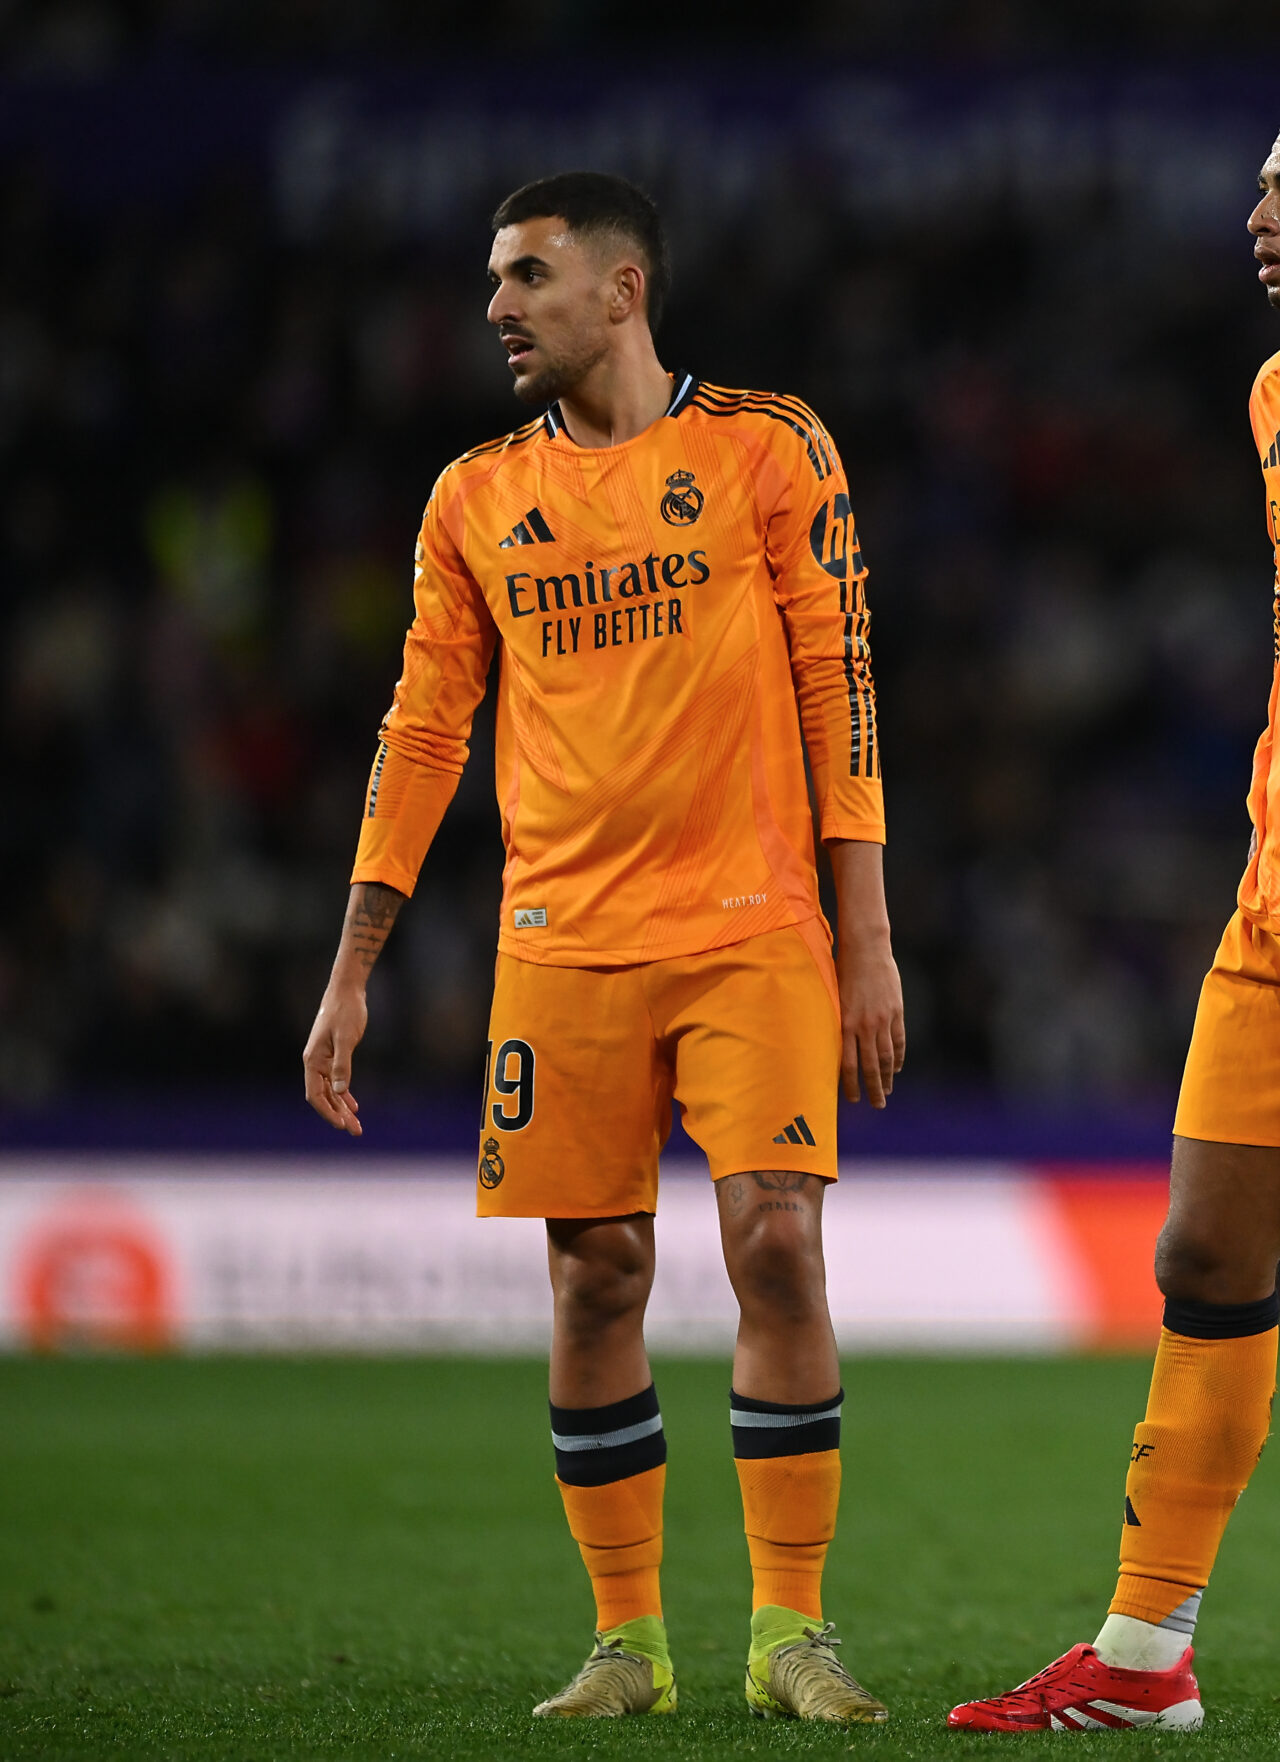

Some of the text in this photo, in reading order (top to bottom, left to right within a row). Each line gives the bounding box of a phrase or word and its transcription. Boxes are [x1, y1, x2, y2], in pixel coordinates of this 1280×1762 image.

[505, 550, 710, 618] Emirates
[542, 599, 683, 657] FLY BETTER
[480, 1038, 535, 1132] 19
